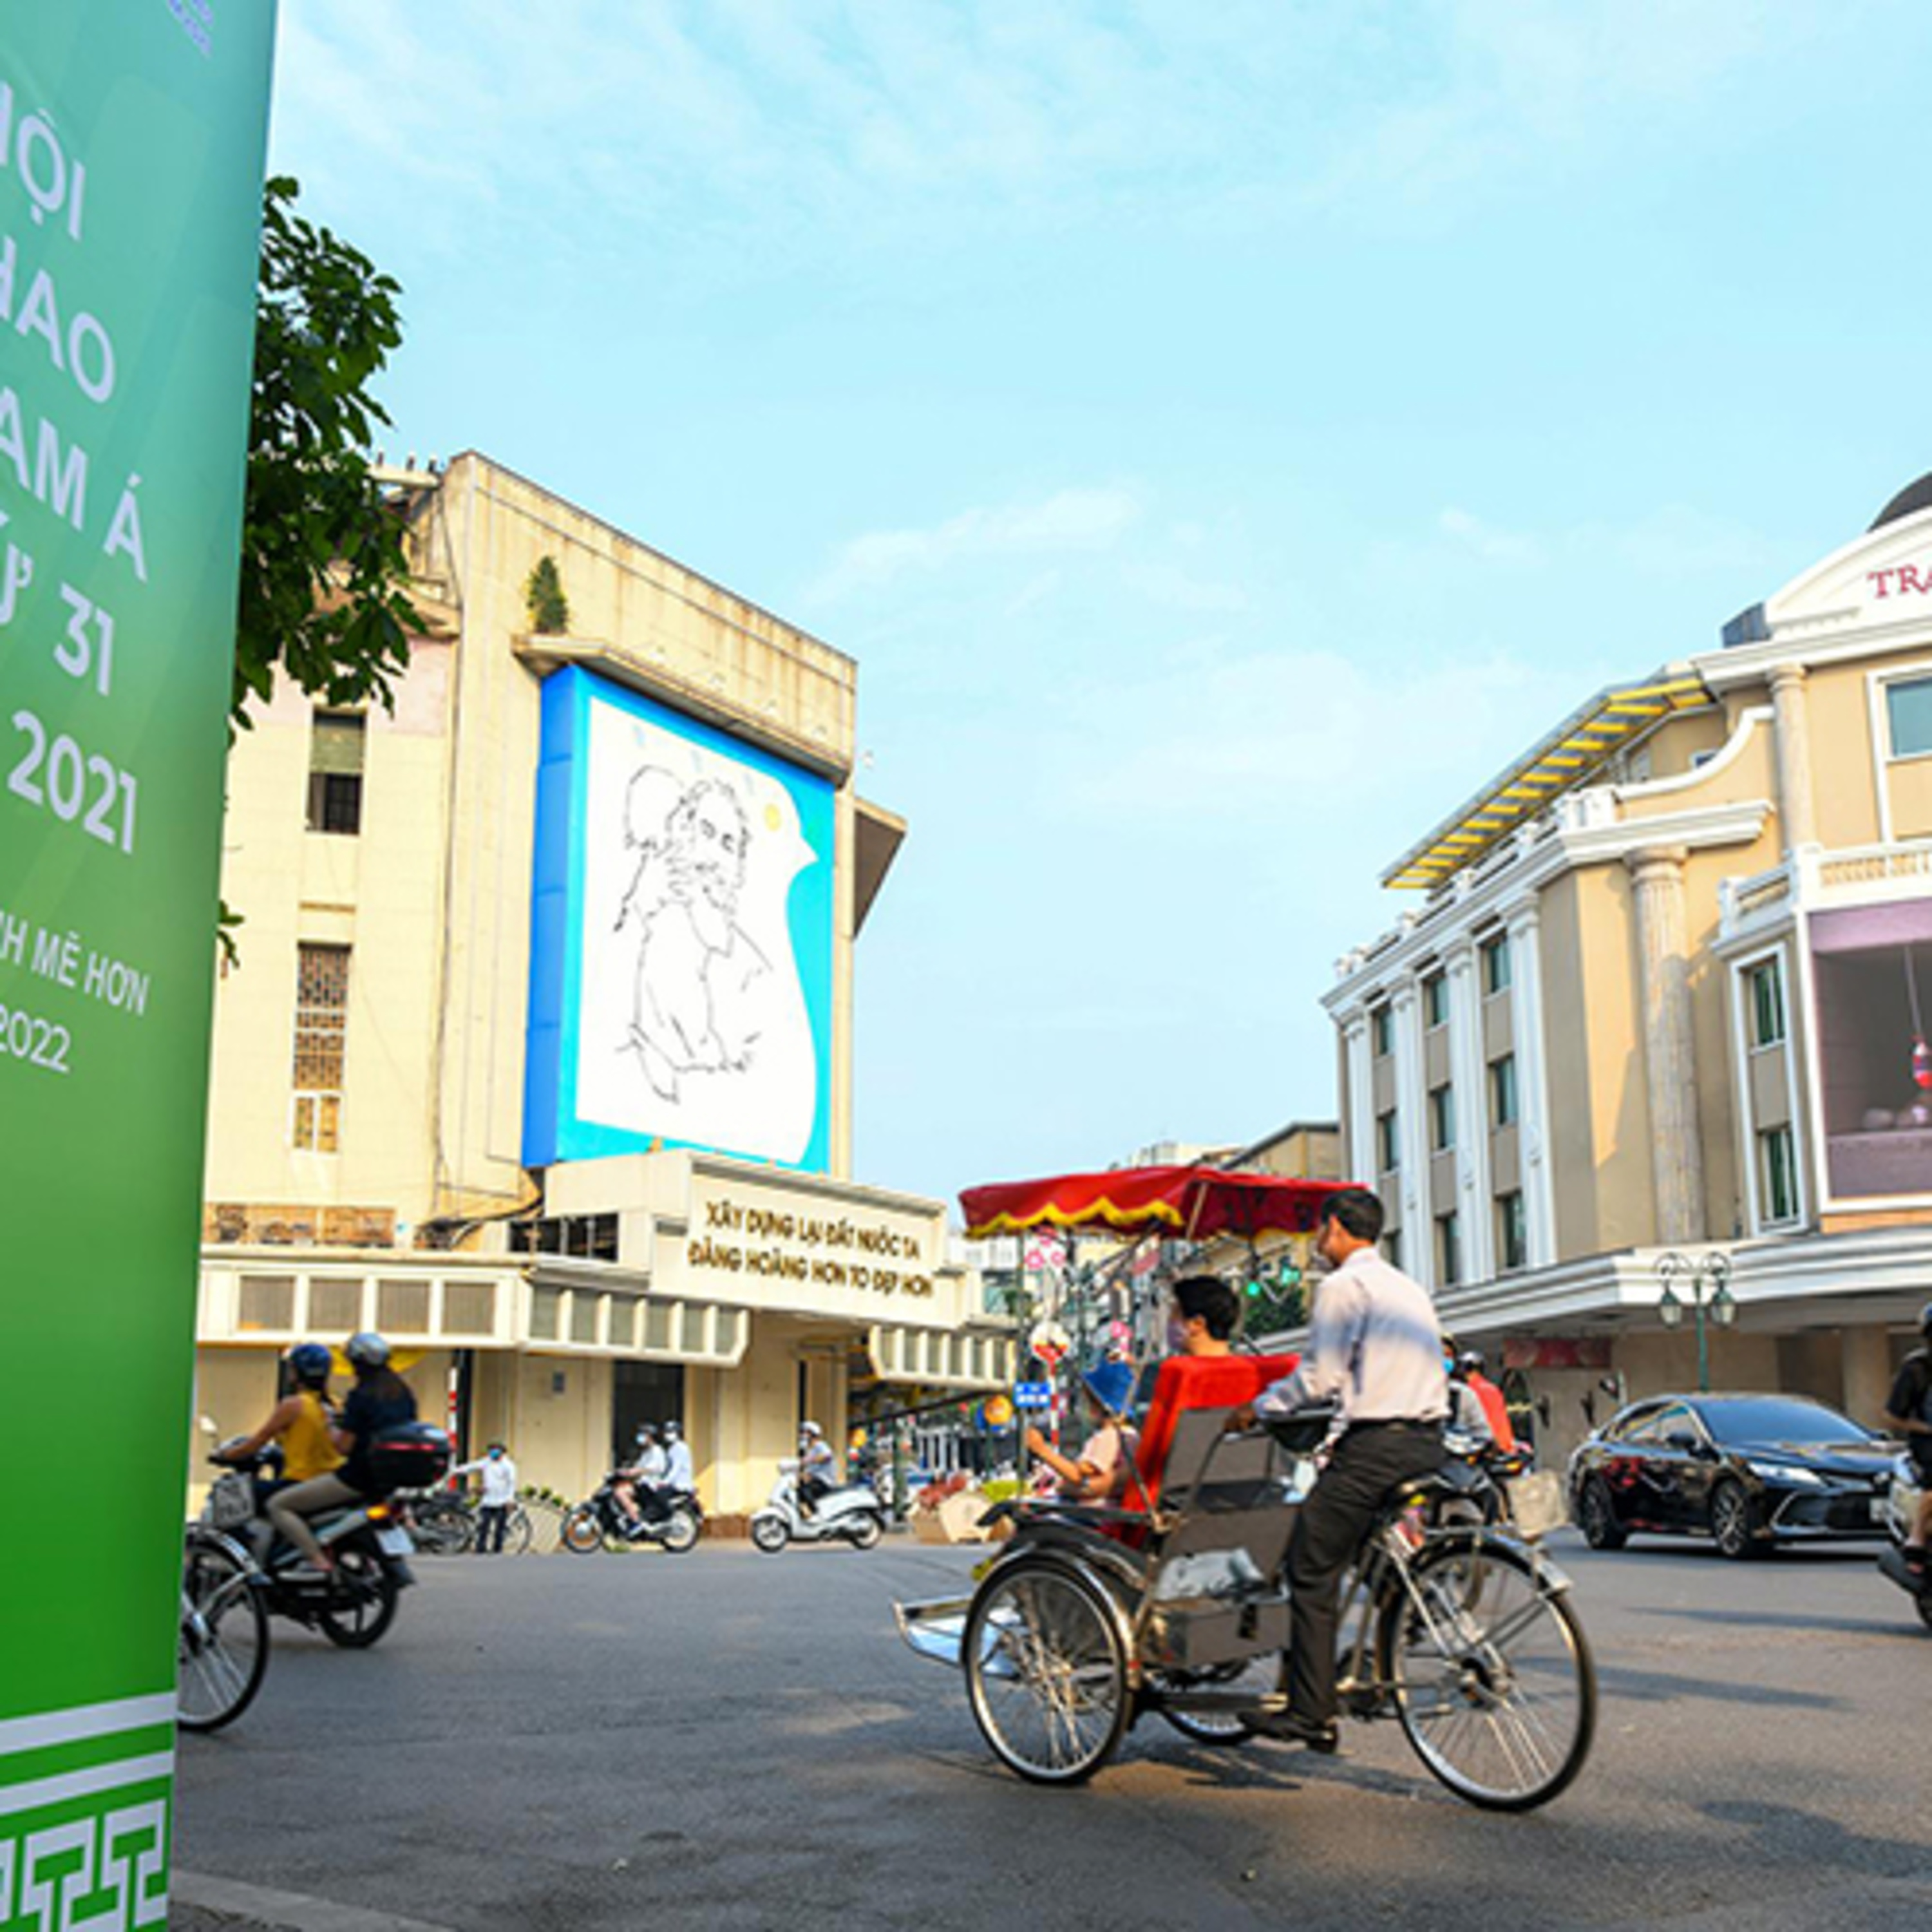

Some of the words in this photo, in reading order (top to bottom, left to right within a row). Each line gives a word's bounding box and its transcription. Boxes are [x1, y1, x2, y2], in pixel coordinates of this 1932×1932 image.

[103, 471, 147, 583] Á
[53, 581, 113, 696] 31
[7, 710, 137, 853] 2021
[32, 927, 80, 988] MẼ
[849, 1264, 869, 1289] TO
